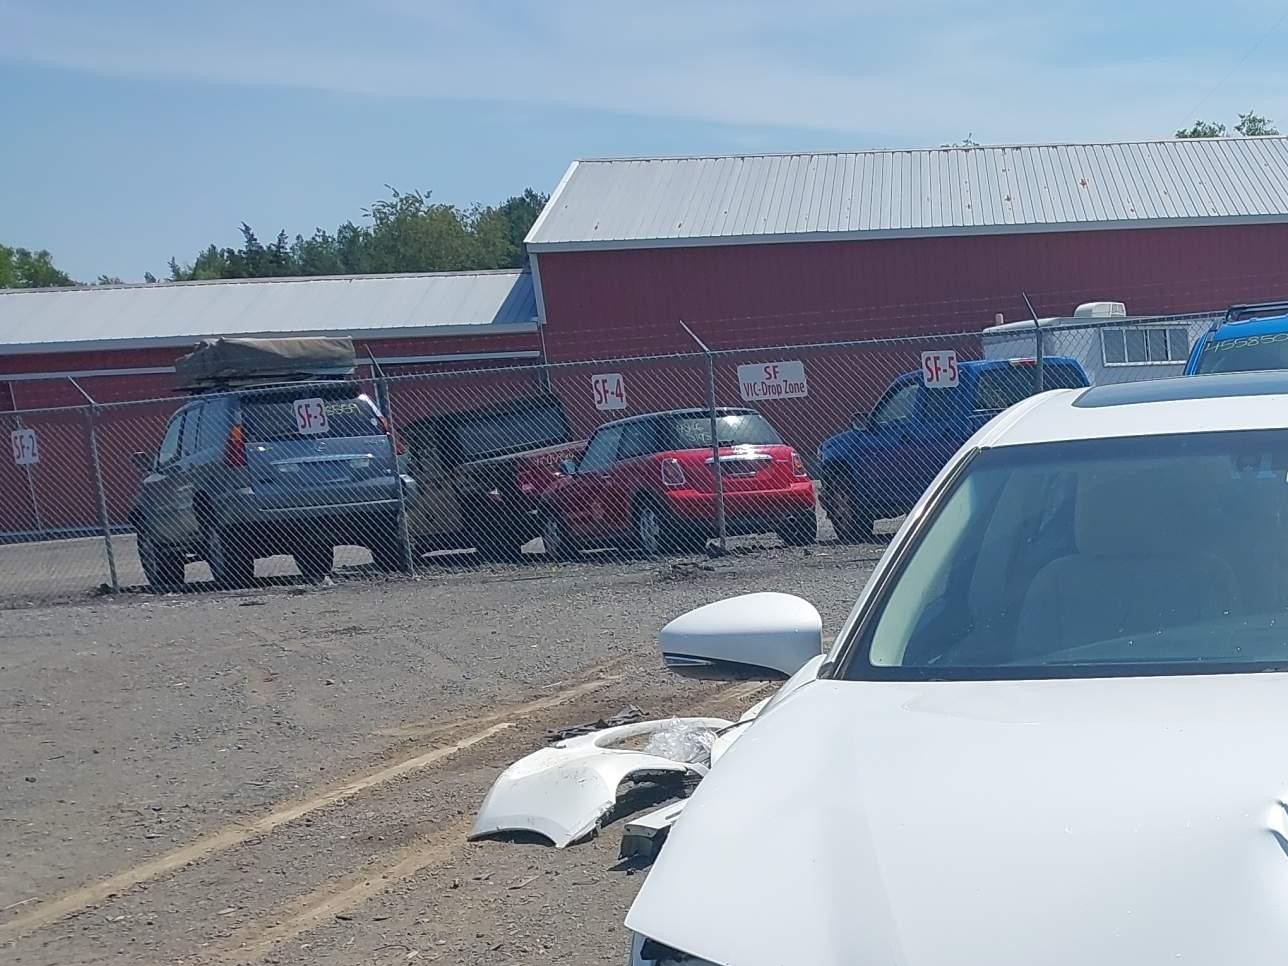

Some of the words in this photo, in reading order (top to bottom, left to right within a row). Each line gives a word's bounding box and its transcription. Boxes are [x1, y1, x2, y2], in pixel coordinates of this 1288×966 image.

[763, 365, 780, 381] SF
[924, 355, 957, 383] SF-5
[593, 378, 624, 405] SF-4
[743, 382, 783, 398] VIC-Drop
[783, 379, 805, 394] Zone
[297, 403, 326, 429] SF-3
[14, 434, 37, 459] SF-2
